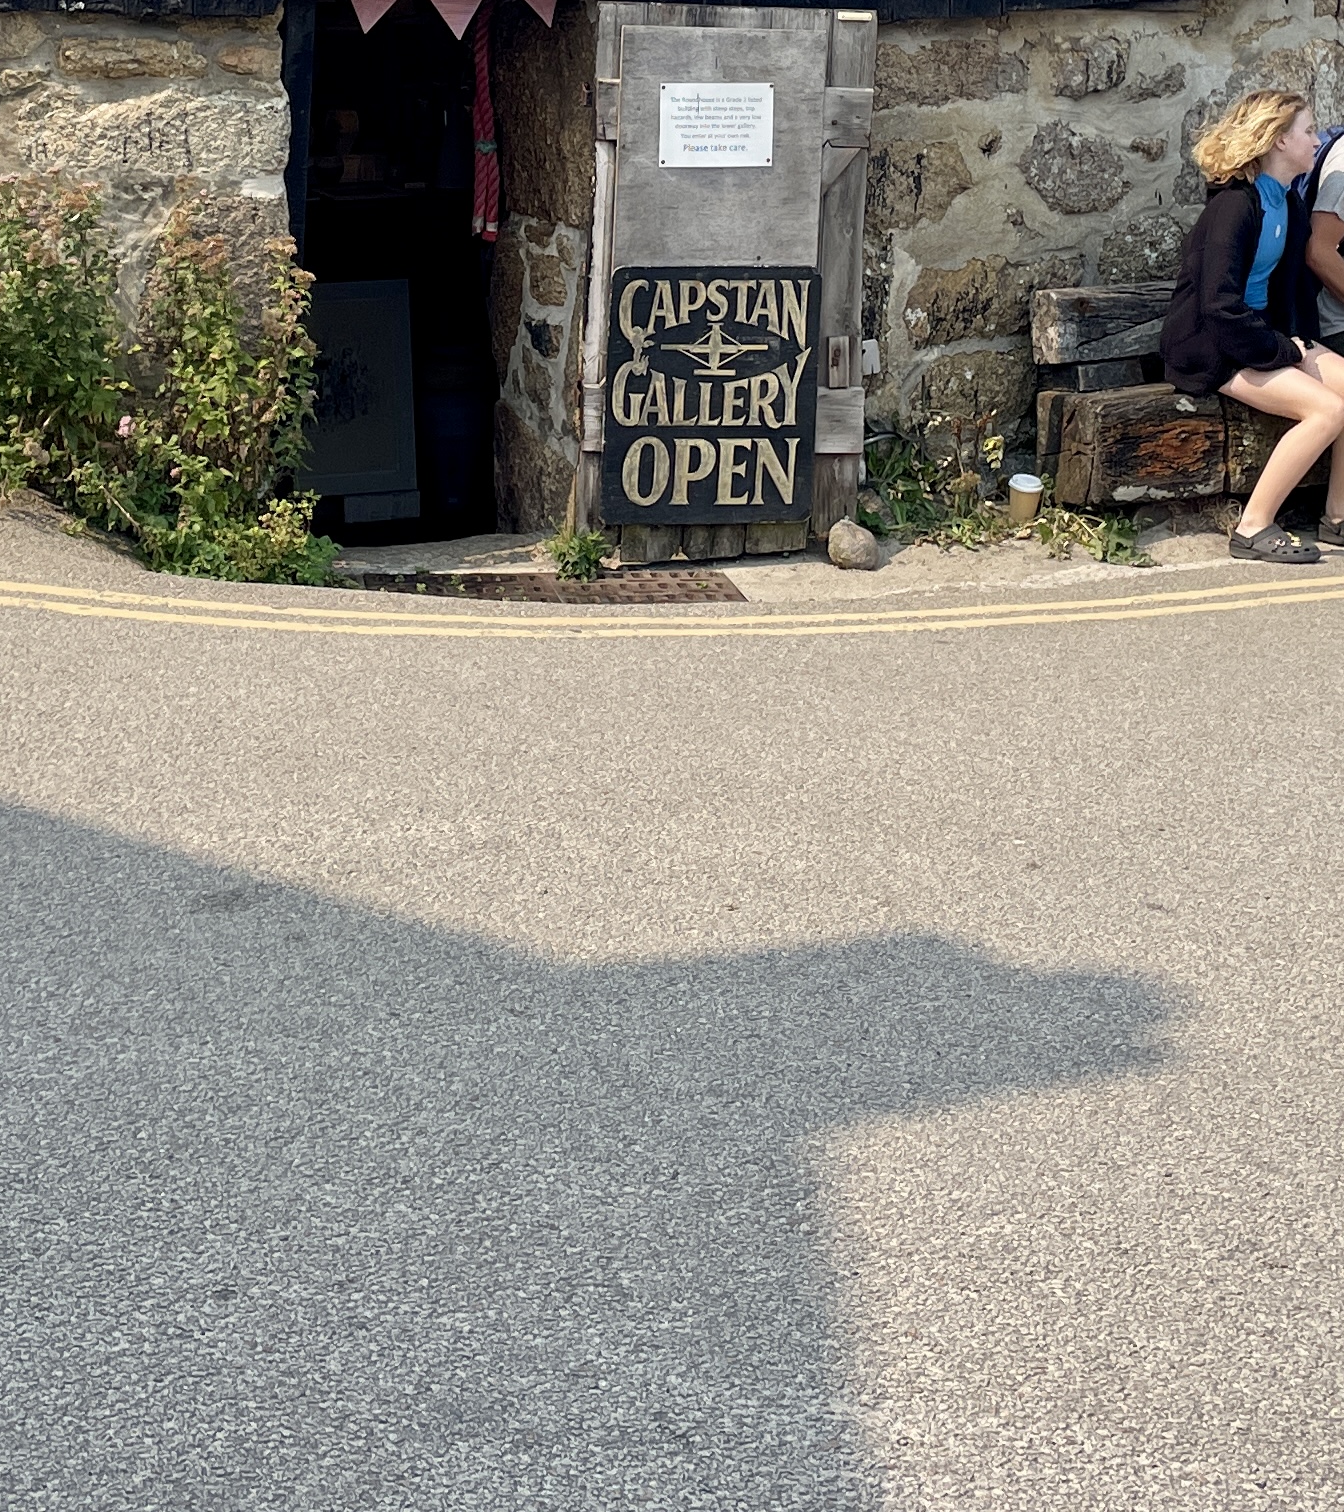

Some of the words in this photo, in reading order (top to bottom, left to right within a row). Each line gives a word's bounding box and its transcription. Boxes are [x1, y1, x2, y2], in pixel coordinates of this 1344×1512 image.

[619, 279, 811, 352] CAPSTAN
[612, 347, 811, 429] GALLERY
[622, 436, 800, 506] OPEN
